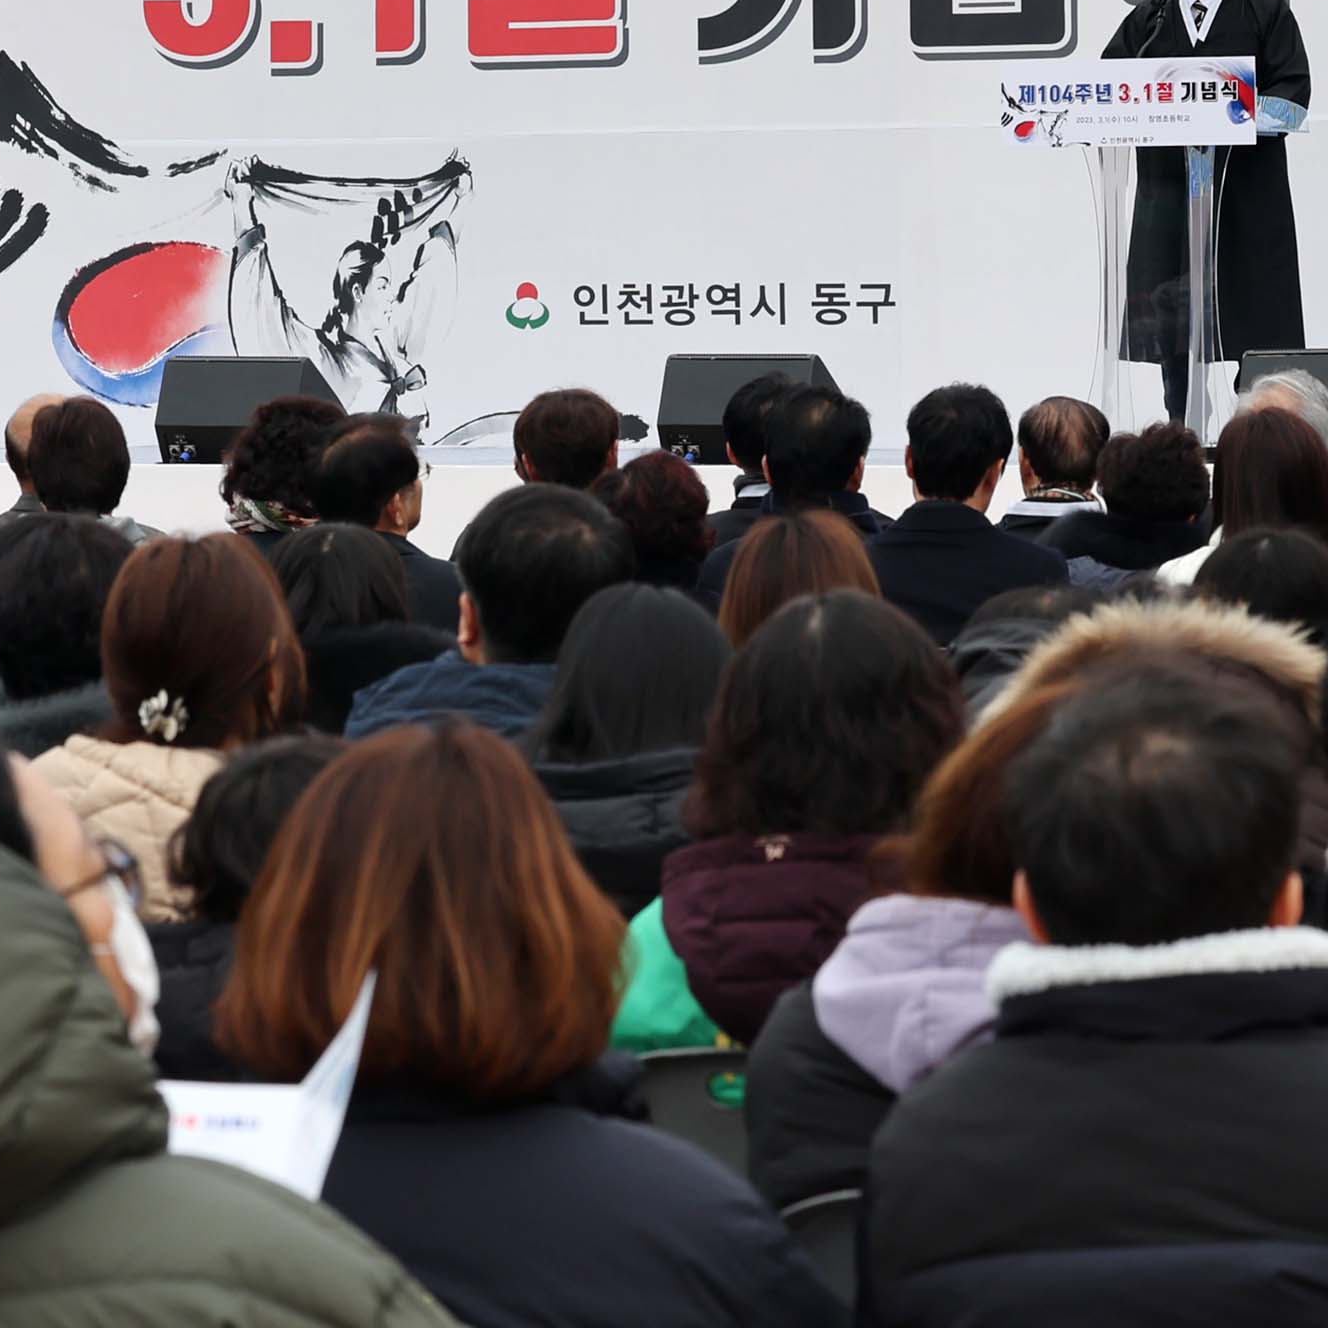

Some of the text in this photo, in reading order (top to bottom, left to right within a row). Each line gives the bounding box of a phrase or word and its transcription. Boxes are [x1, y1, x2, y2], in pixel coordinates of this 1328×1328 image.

[1018, 79, 1239, 104] 제104주년 3.1절 기념식
[573, 282, 896, 326] 인천광역시 동구
